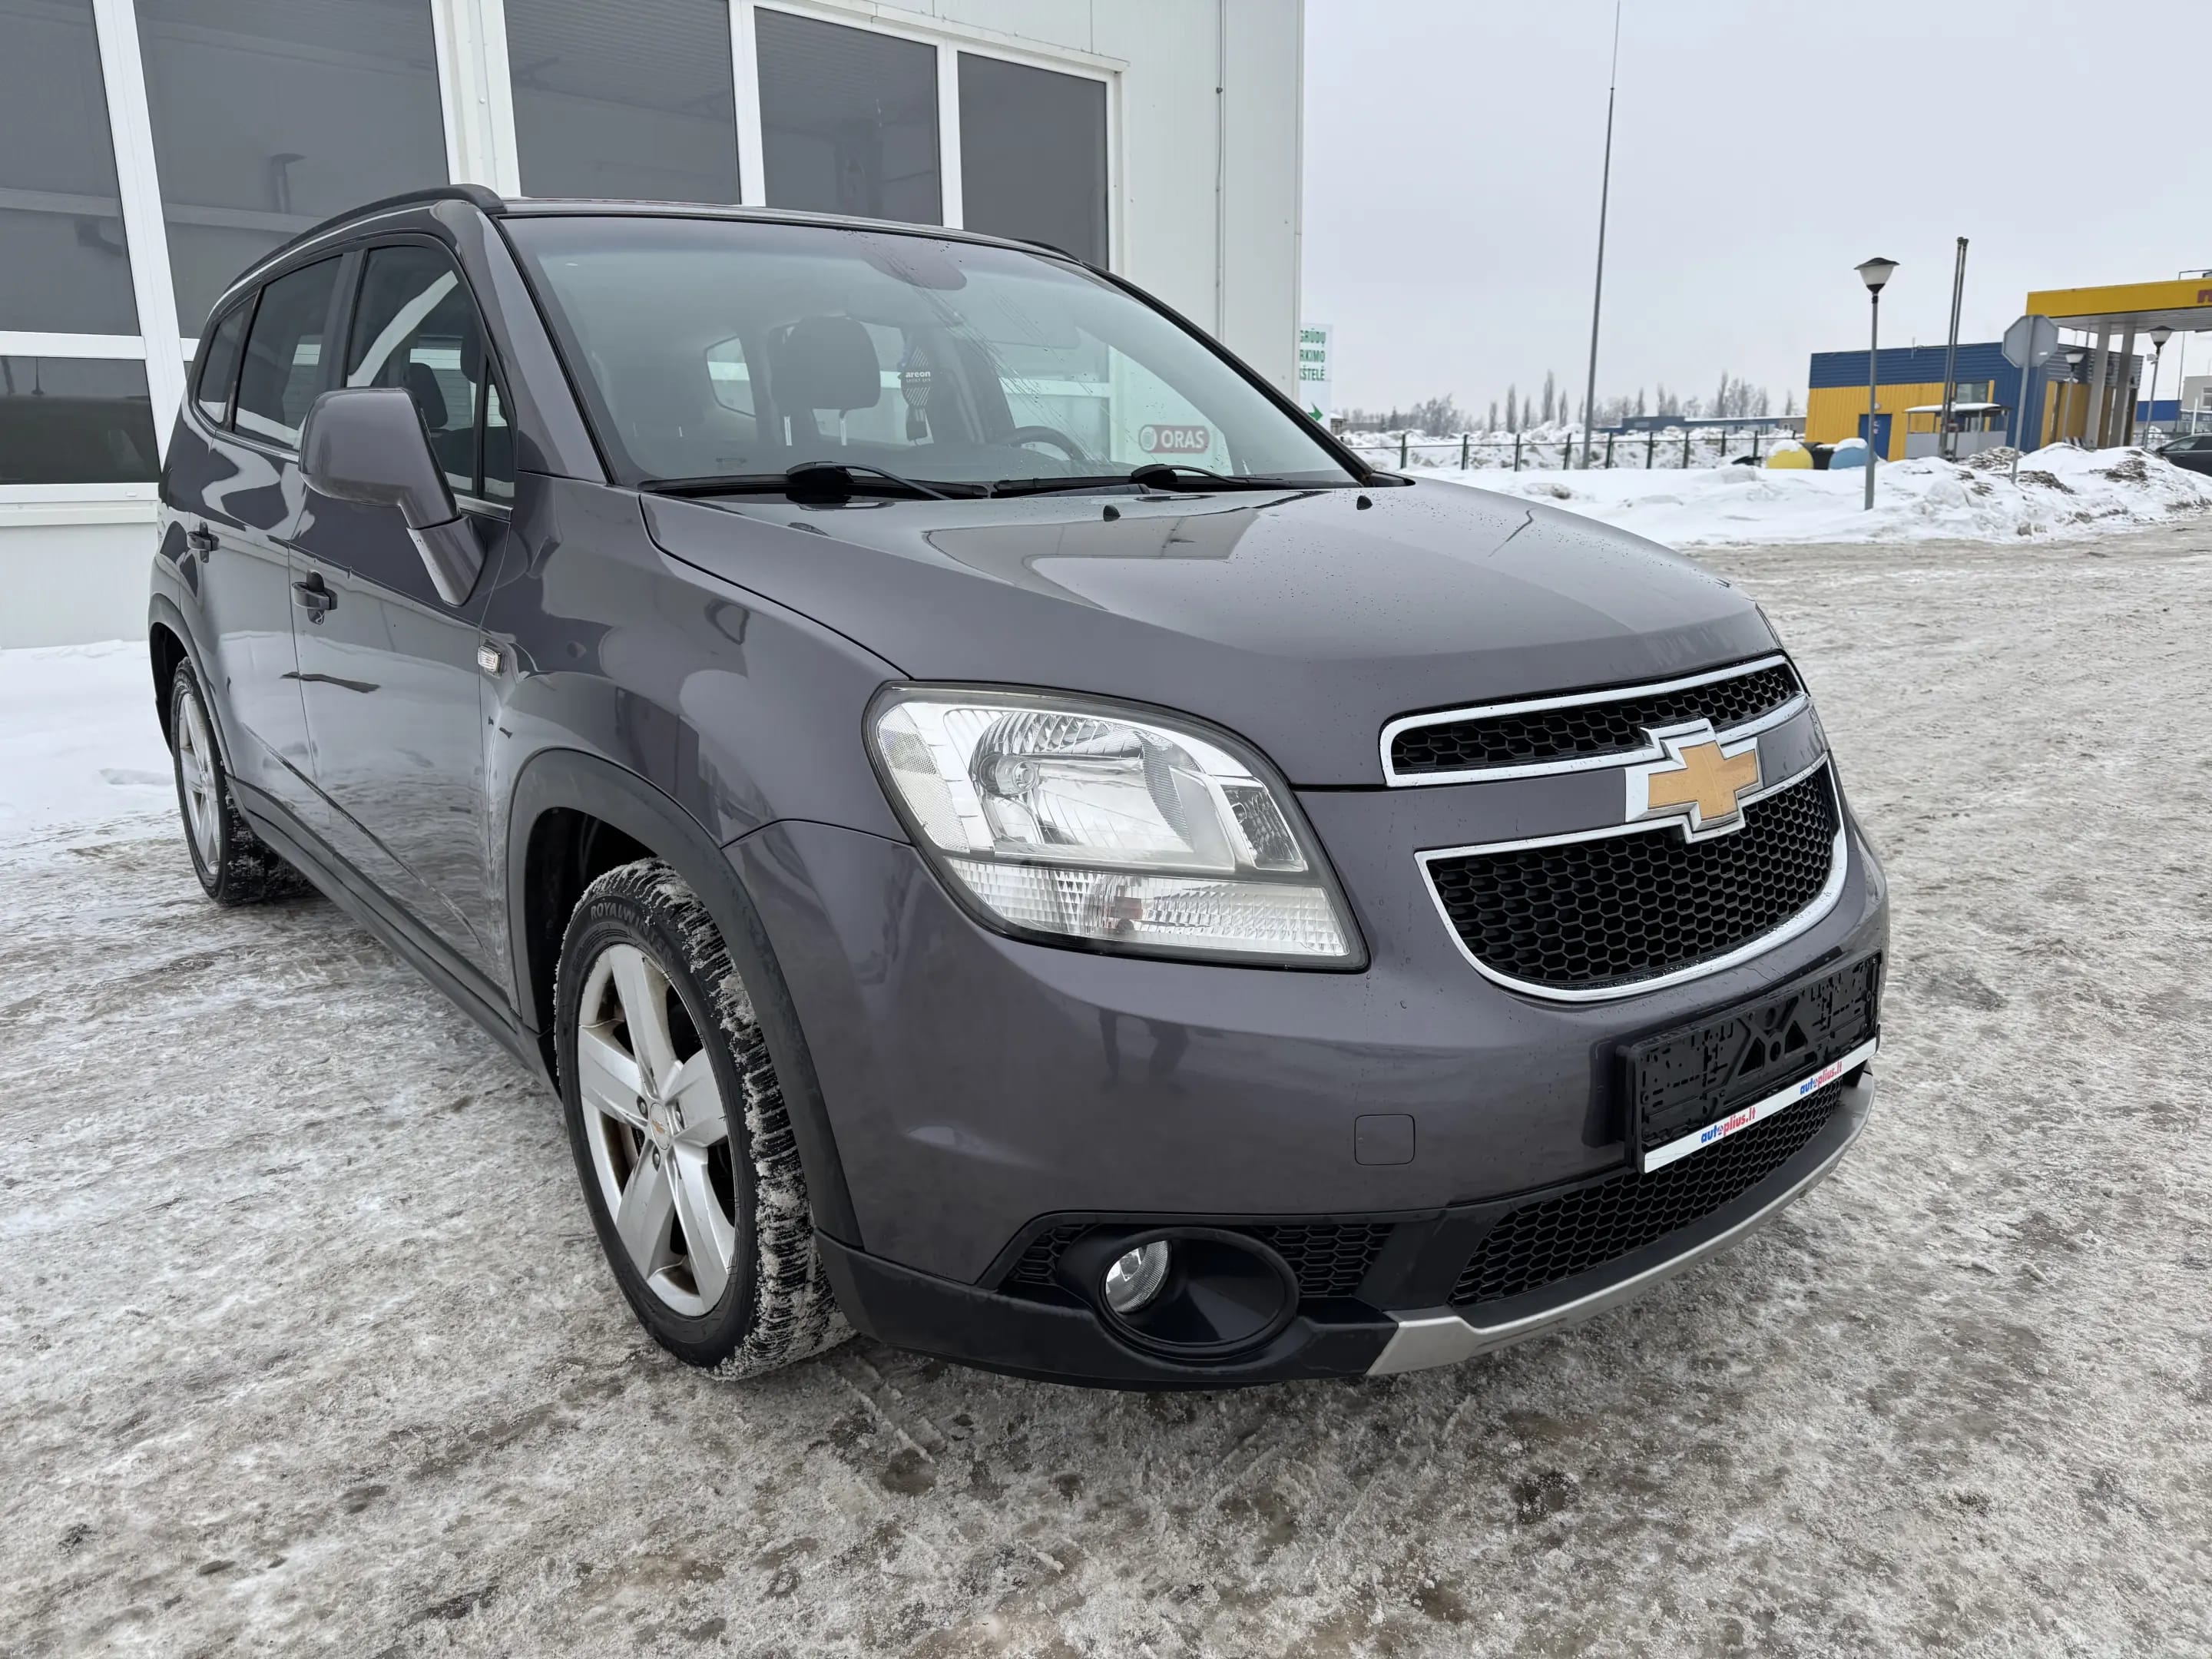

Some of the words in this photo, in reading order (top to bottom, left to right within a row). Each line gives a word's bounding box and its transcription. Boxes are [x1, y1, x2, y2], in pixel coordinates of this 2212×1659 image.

[1161, 430, 1205, 449] ORAS
[1800, 1061, 1843, 1095] autoplius.lt
[1700, 1107, 1757, 1144] autoplius.lt
